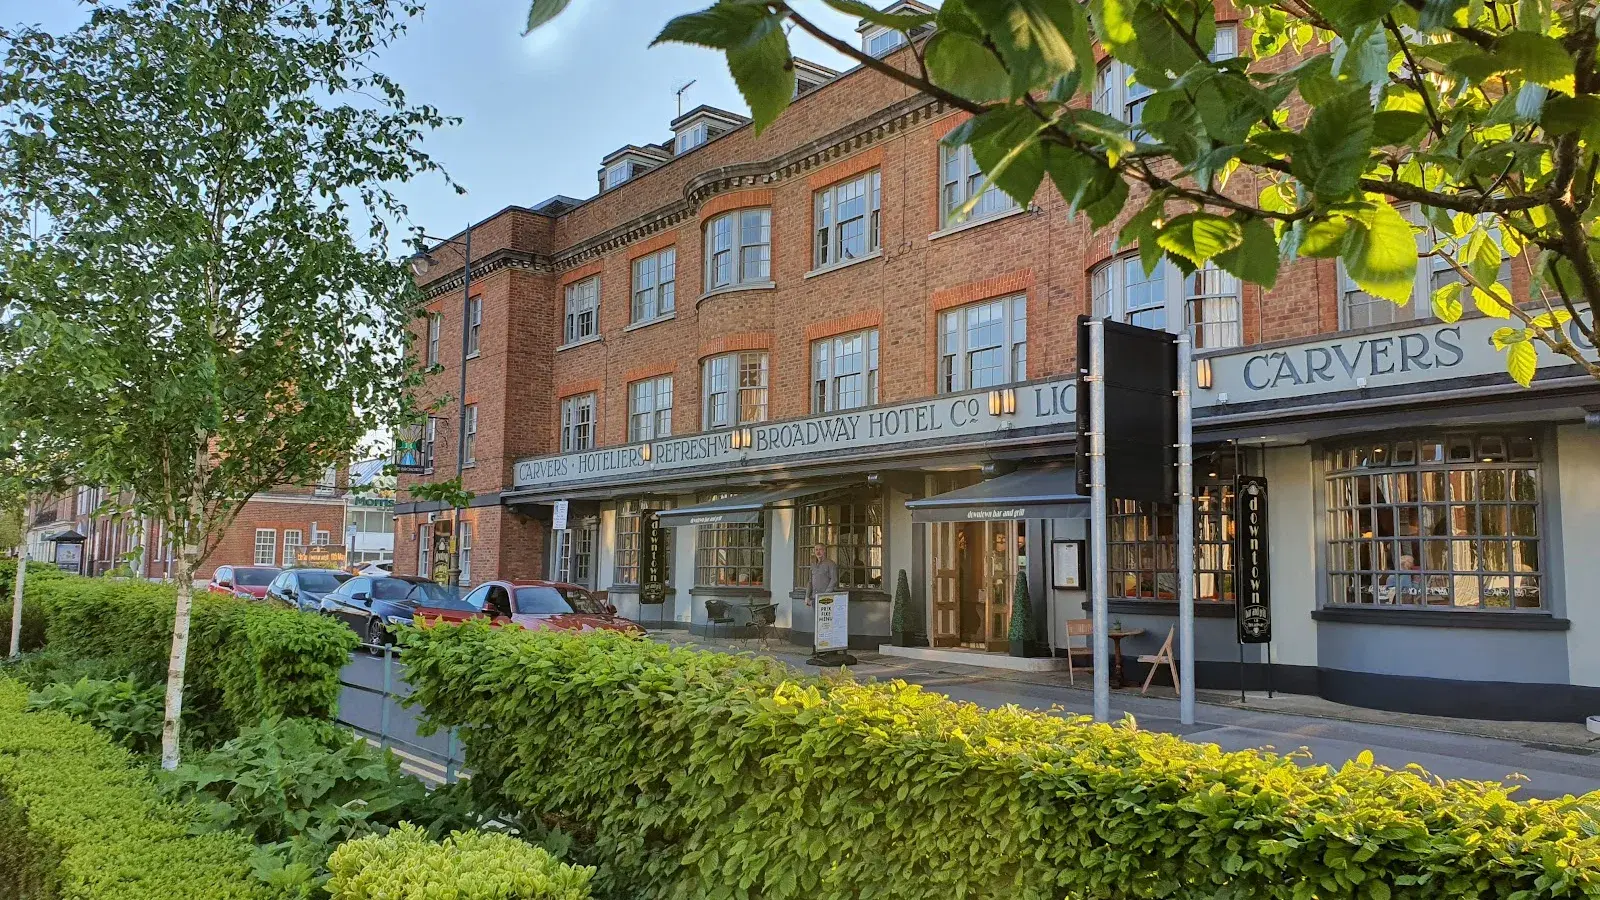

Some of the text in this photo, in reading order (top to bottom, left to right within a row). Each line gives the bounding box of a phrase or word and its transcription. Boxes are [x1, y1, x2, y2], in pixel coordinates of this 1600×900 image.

[1243, 327, 1464, 390] CARVERS
[519, 457, 568, 481] CARVERS
[578, 448, 645, 474] HOTELIERS
[757, 414, 861, 452] BROADWAY
[869, 404, 943, 438] HOTEL
[1035, 384, 1077, 417] LIC
[650, 519, 660, 582] downtown
[1249, 496, 1260, 604] downtown
